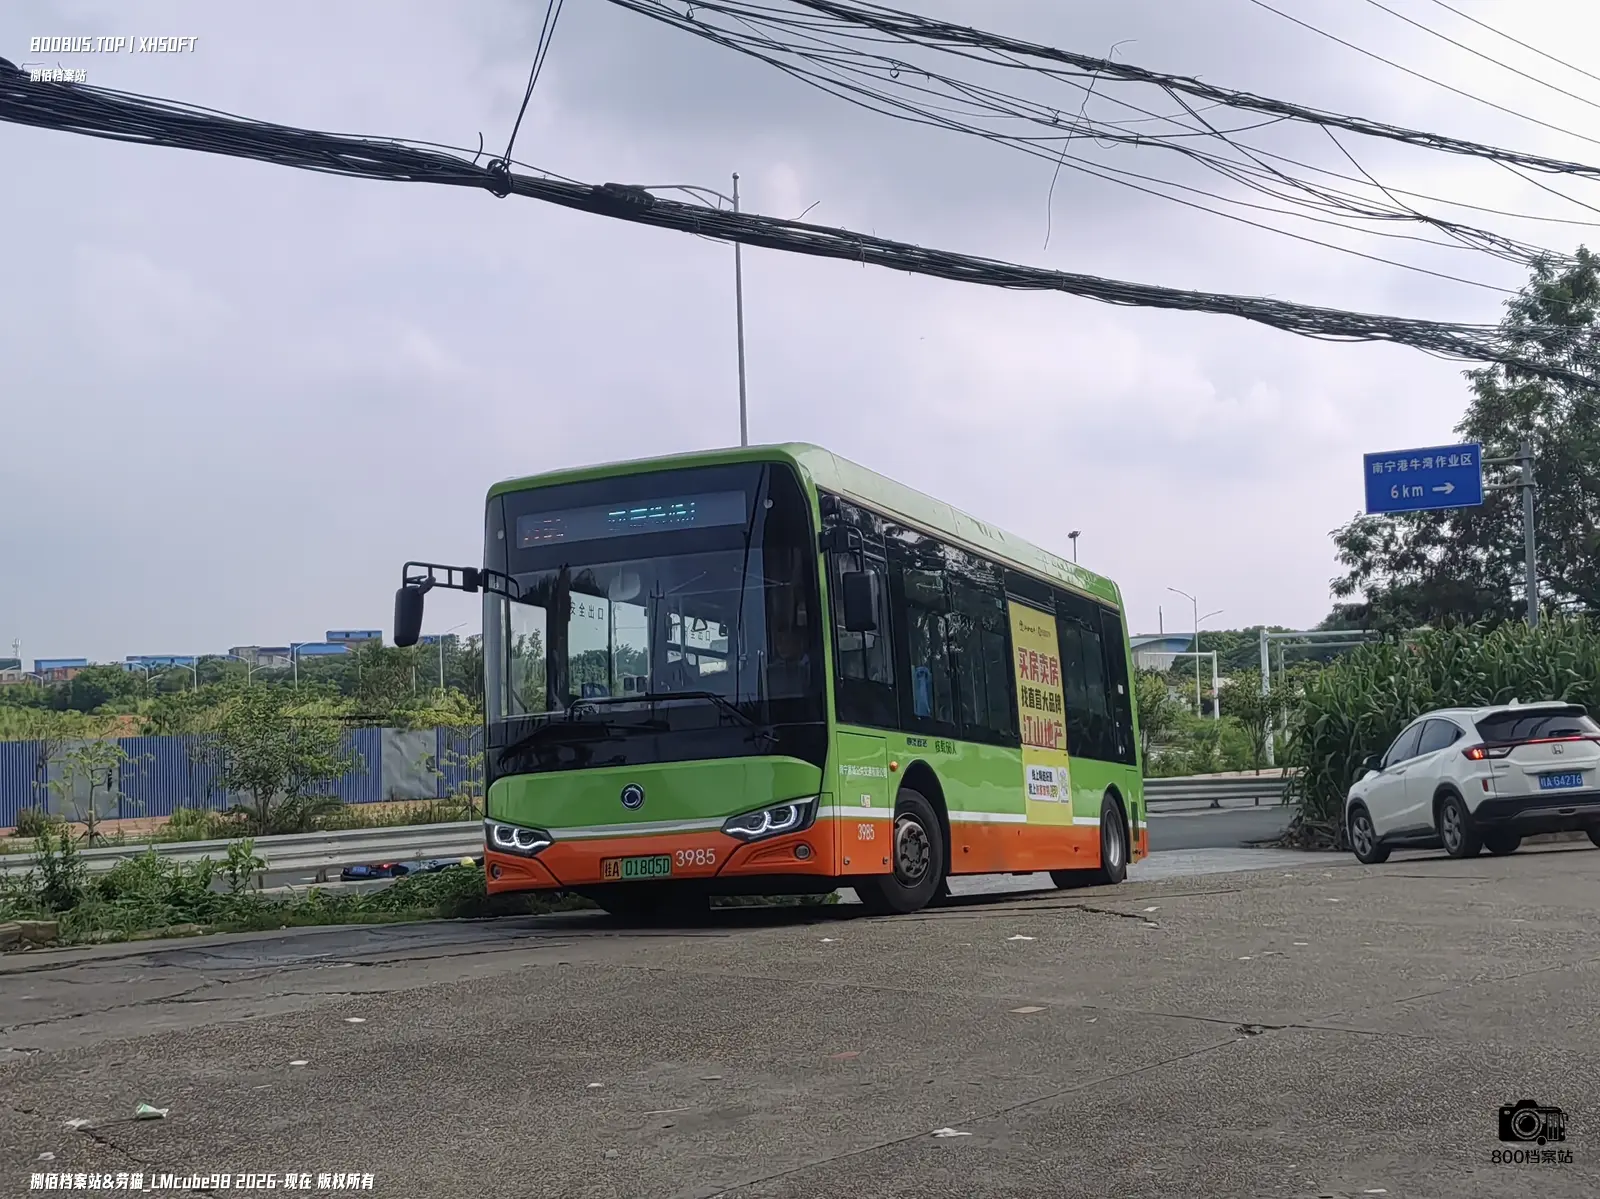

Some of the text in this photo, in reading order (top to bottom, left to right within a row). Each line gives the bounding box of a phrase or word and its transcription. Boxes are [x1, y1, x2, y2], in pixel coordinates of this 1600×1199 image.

[1372, 453, 1473, 474] 南宁港牛湾作业区
[1017, 646, 1060, 687] 买房卖房
[1021, 685, 1063, 715] 找直营大品牌
[1023, 714, 1064, 750] 江山地产
[857, 823, 876, 841] 3985
[675, 848, 716, 867] 3985
